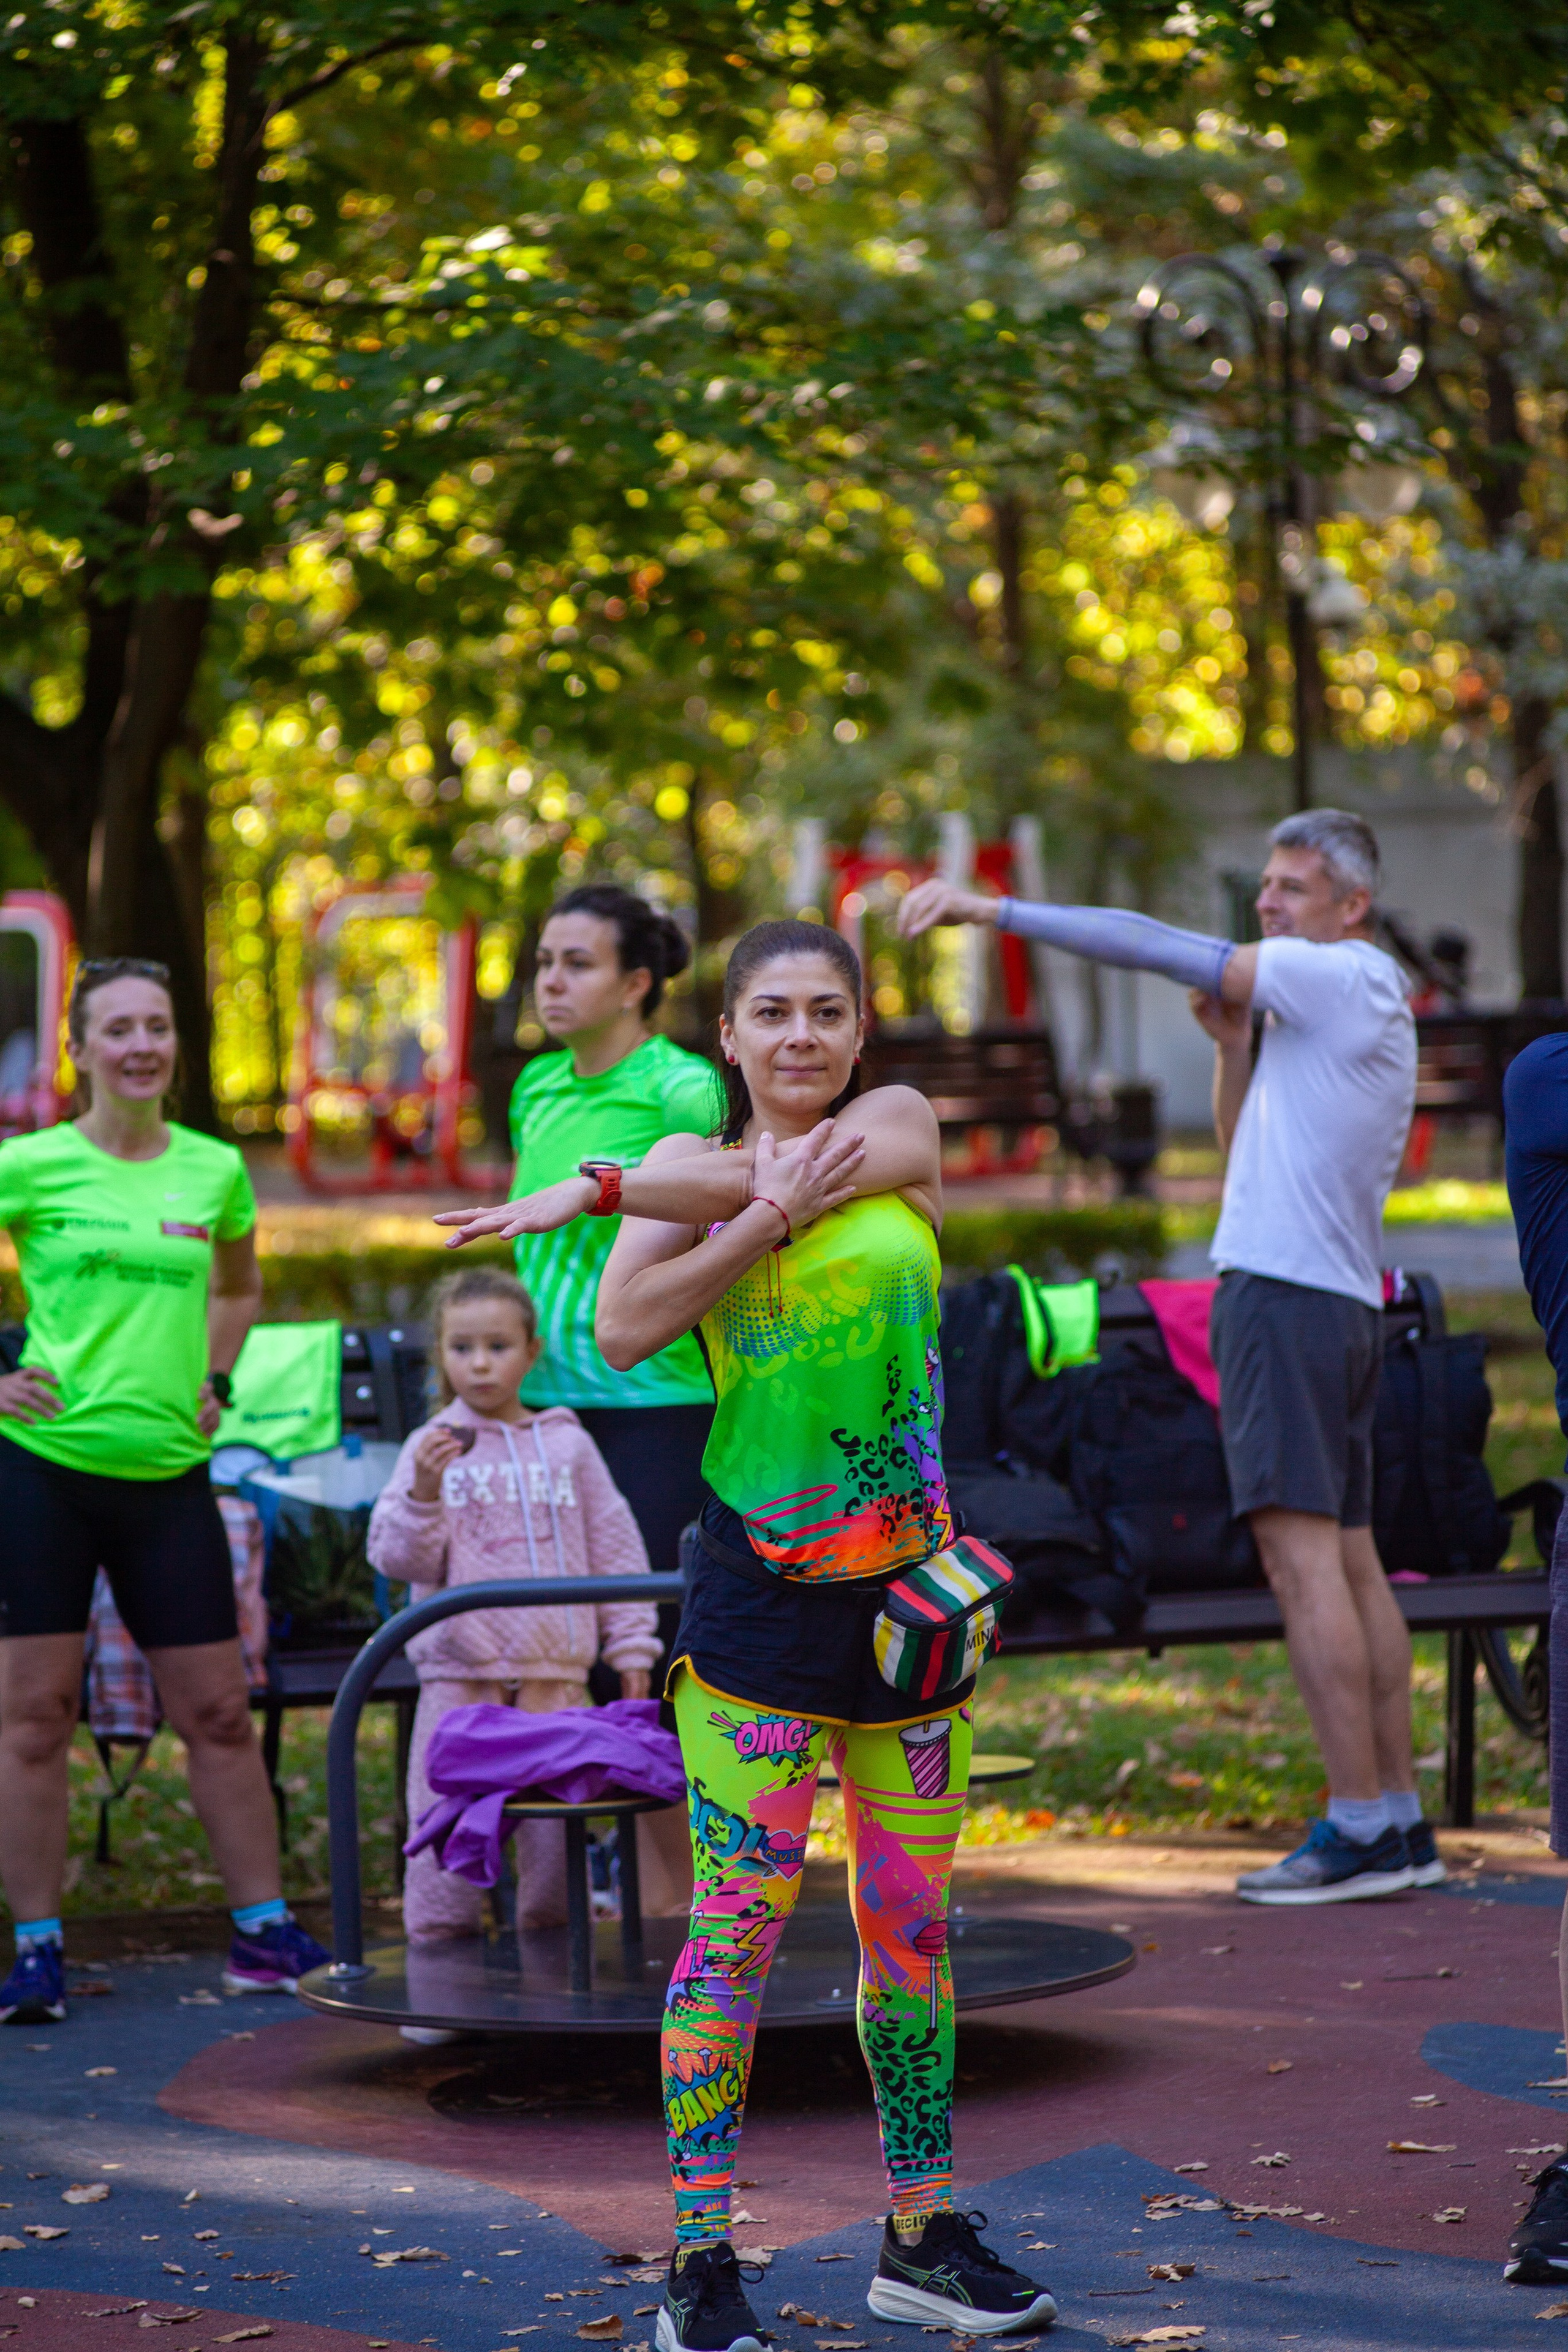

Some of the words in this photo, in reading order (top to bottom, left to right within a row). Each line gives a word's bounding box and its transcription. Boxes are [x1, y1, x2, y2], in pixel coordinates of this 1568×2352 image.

[443, 1463, 576, 1508] EXTRA
[735, 1719, 812, 1755] OMG!
[765, 1849, 803, 1862] MUSI
[667, 2058, 747, 2138] BANG!
